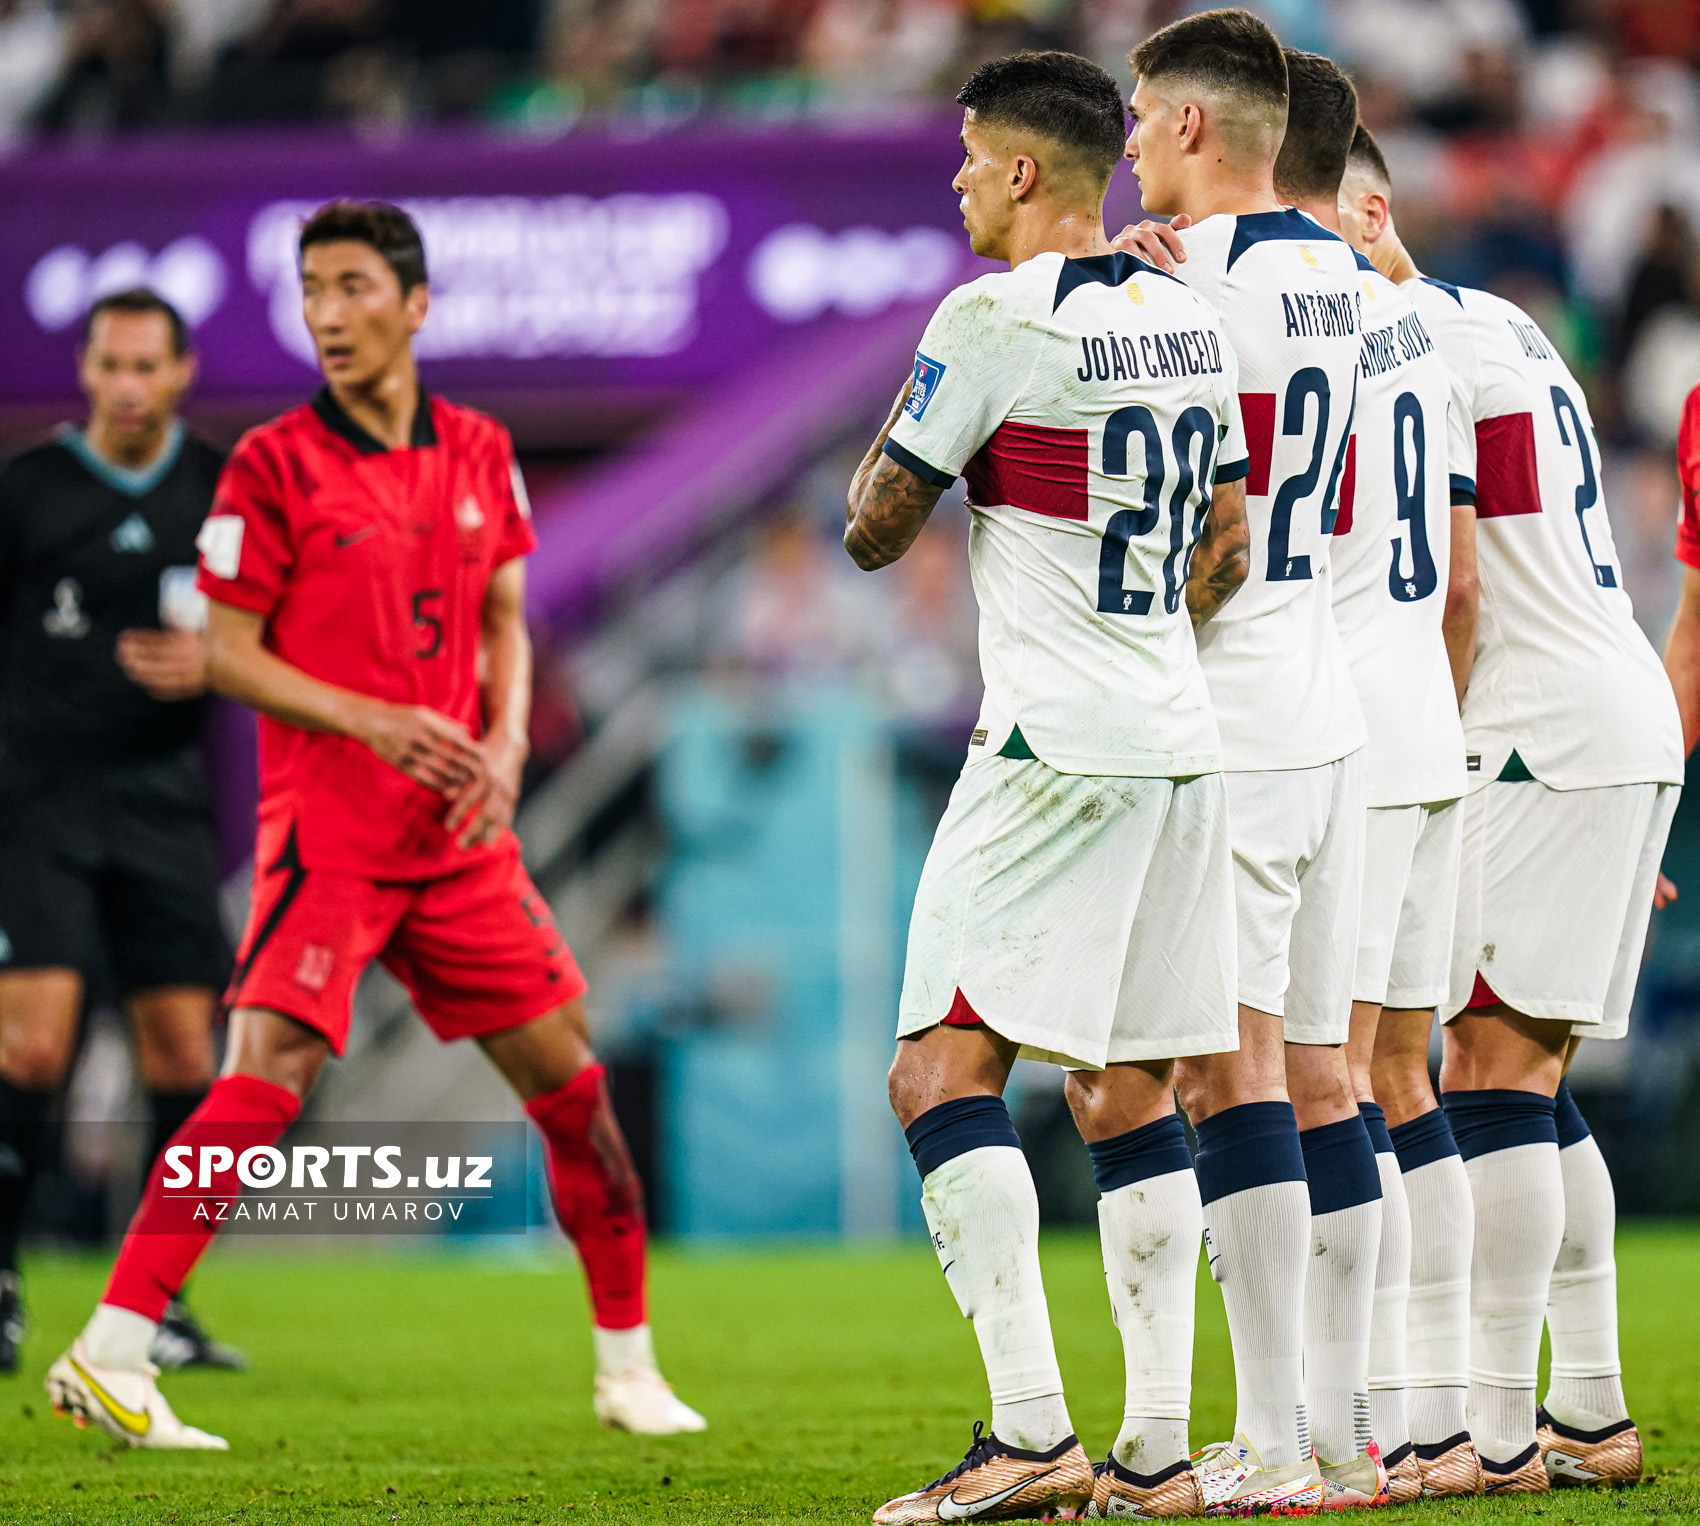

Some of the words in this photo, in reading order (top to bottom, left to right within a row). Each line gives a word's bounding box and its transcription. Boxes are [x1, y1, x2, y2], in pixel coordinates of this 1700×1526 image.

[1077, 331, 1140, 382] JOÃO
[1139, 330, 1222, 379] CANCELO
[1397, 310, 1435, 361] SILVA
[1096, 406, 1215, 615] 20
[1388, 391, 1438, 602] 9
[1550, 385, 1618, 588] 2
[411, 590, 443, 659] 5
